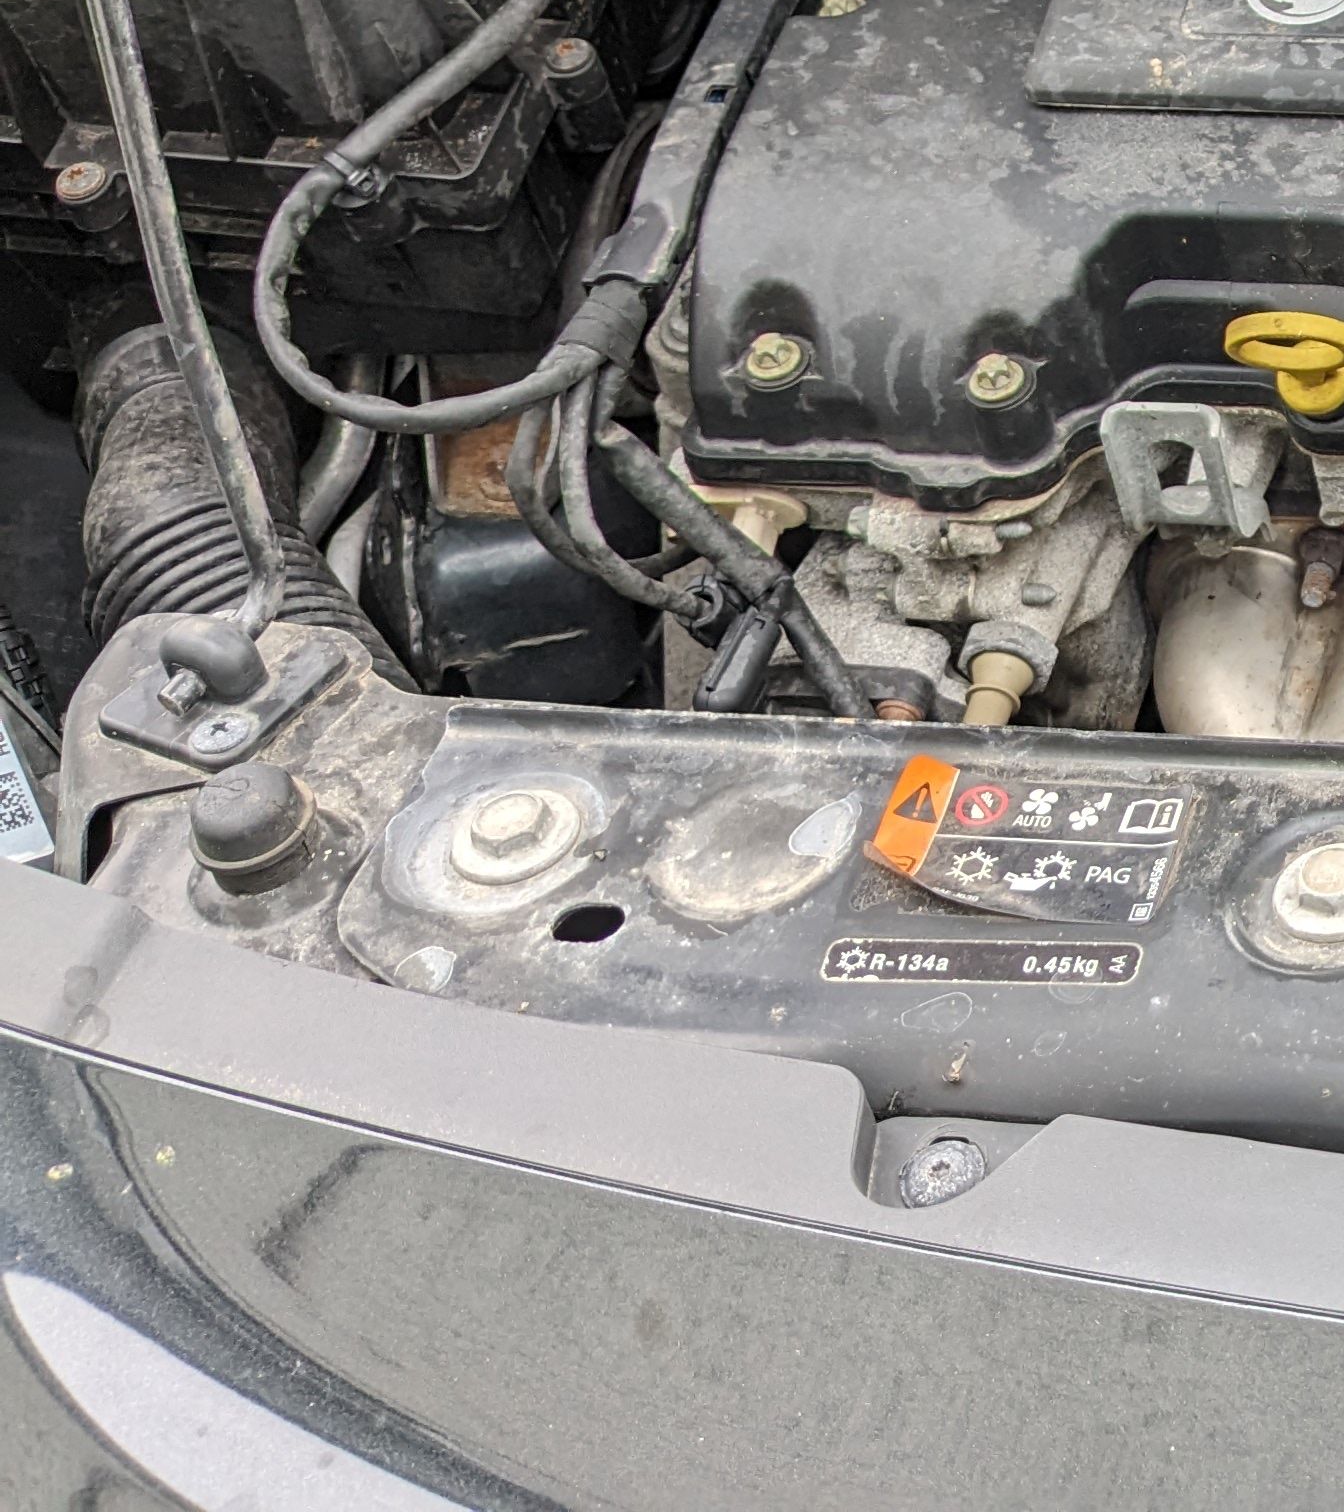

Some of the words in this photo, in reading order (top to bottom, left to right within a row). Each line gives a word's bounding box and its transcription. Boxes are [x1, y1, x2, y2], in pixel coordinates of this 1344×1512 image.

[1012, 814, 1053, 828] AUTO
[1085, 866, 1132, 885] PAG
[869, 953, 949, 972] R-134a
